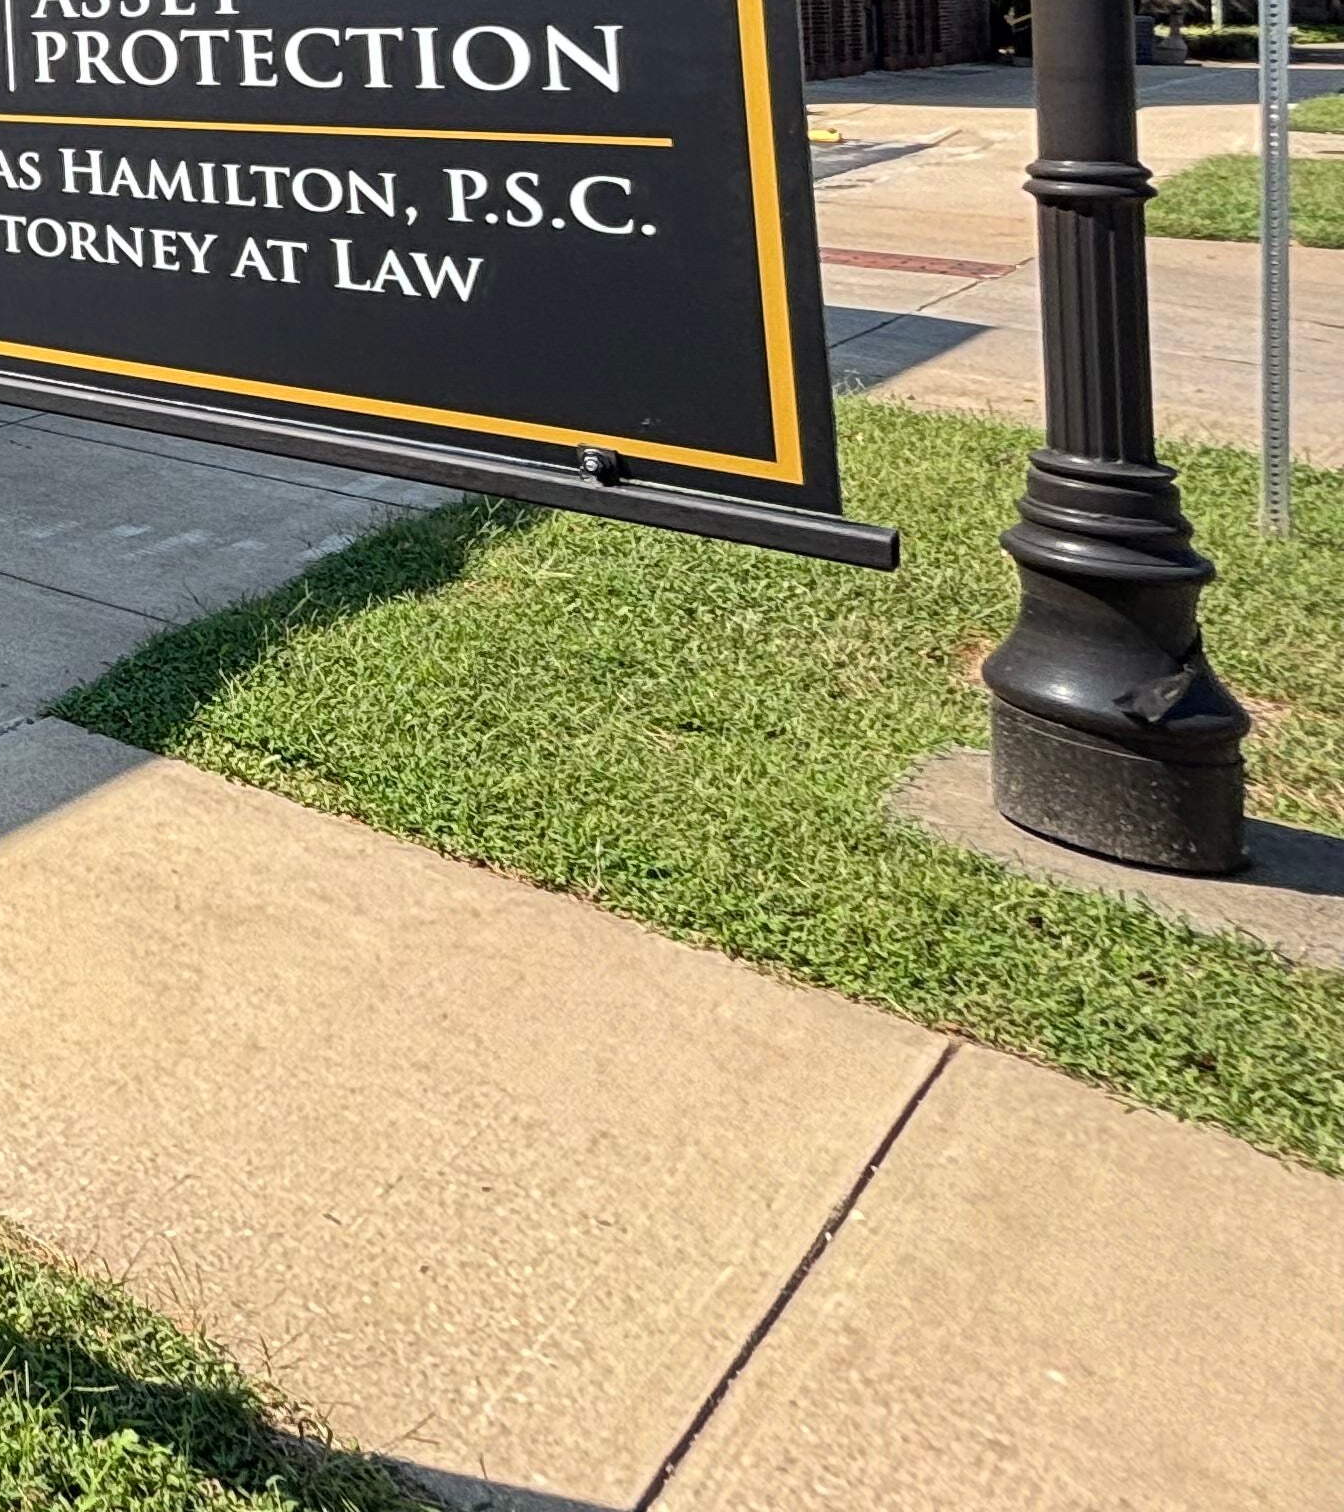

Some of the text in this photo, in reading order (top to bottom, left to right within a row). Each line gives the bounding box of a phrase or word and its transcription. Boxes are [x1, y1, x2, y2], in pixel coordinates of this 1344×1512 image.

[31, 25, 624, 93] PROTECTION
[58, 148, 419, 226] HAMILTON,
[442, 168, 657, 236] P.S.C.
[230, 236, 308, 284] AT
[329, 238, 484, 302] LAW
